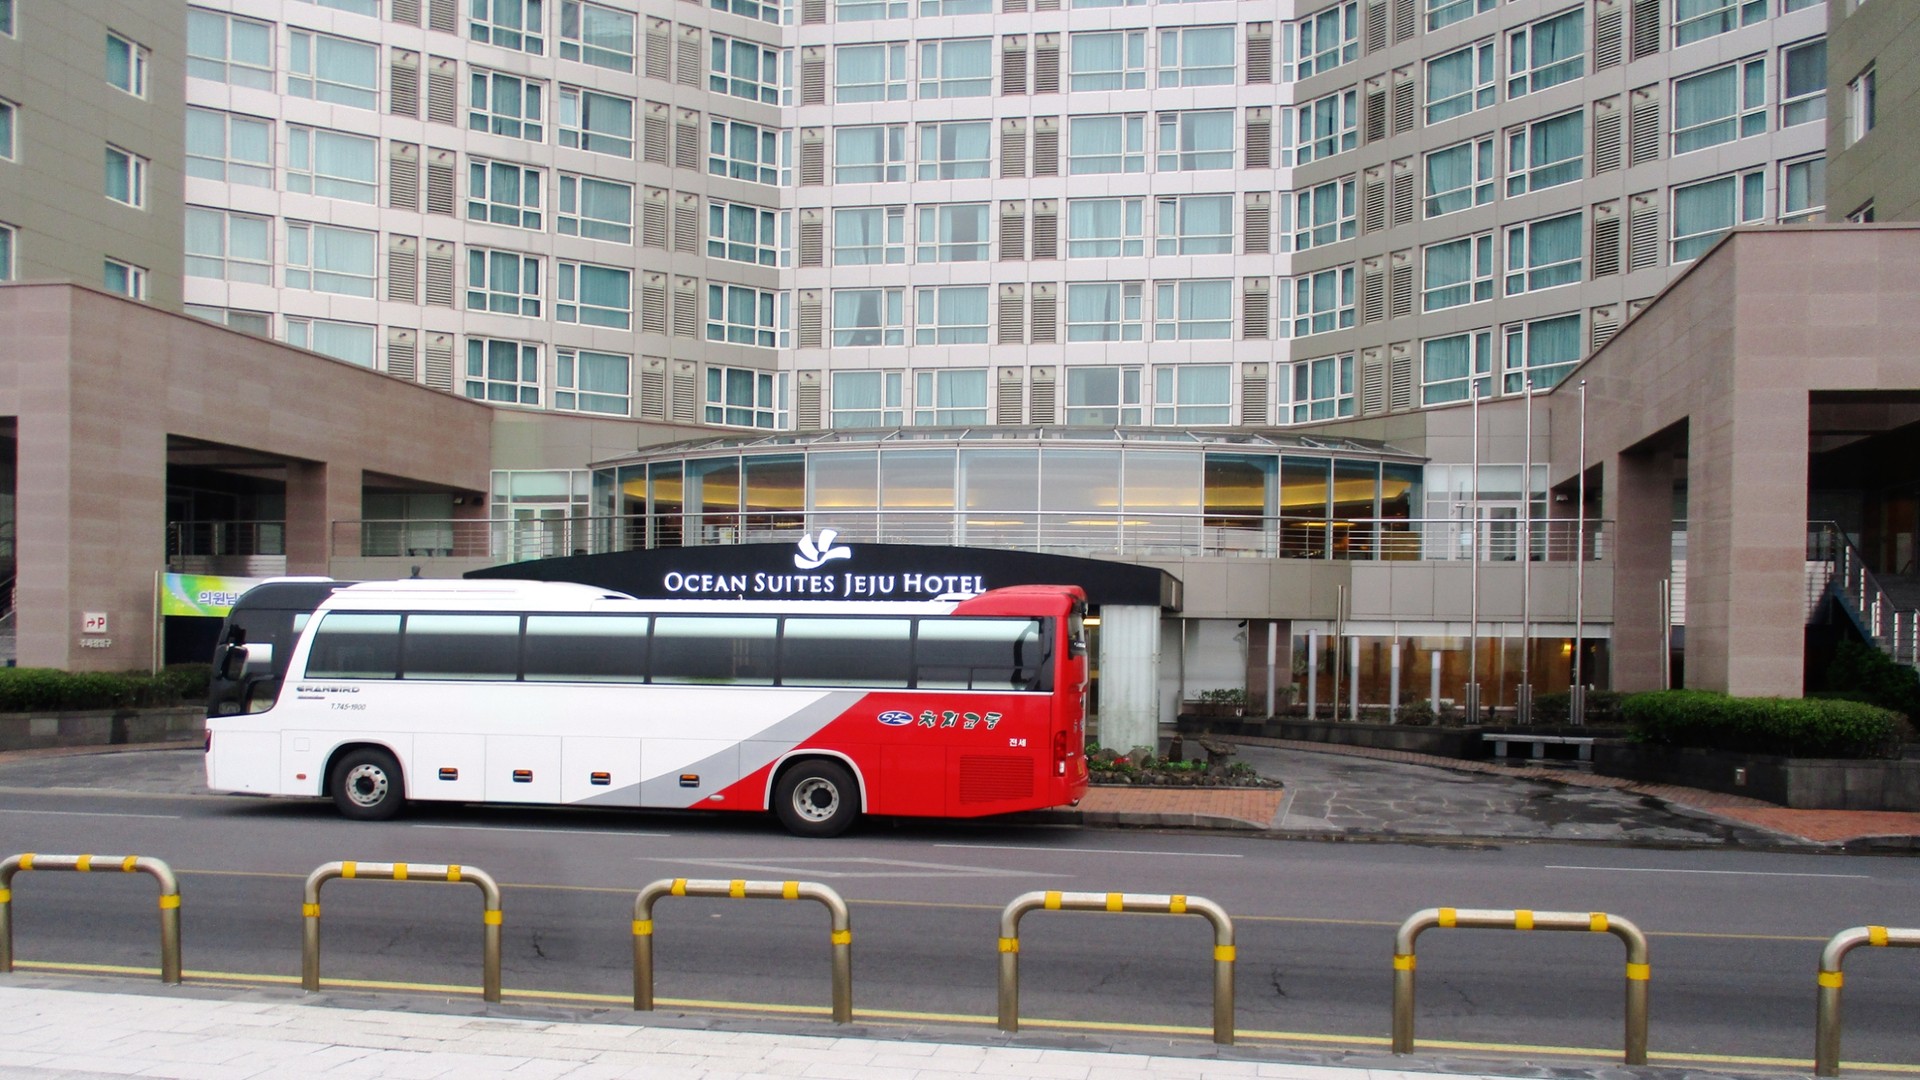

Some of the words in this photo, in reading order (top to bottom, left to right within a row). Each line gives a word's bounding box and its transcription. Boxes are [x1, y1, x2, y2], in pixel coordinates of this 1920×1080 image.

[664, 573, 747, 593] OCEAN
[754, 573, 835, 594] SUITES
[844, 573, 895, 597] JEJU
[903, 574, 987, 594] HOTEL
[97, 617, 105, 629] P
[1009, 738, 1027, 747] 전세
